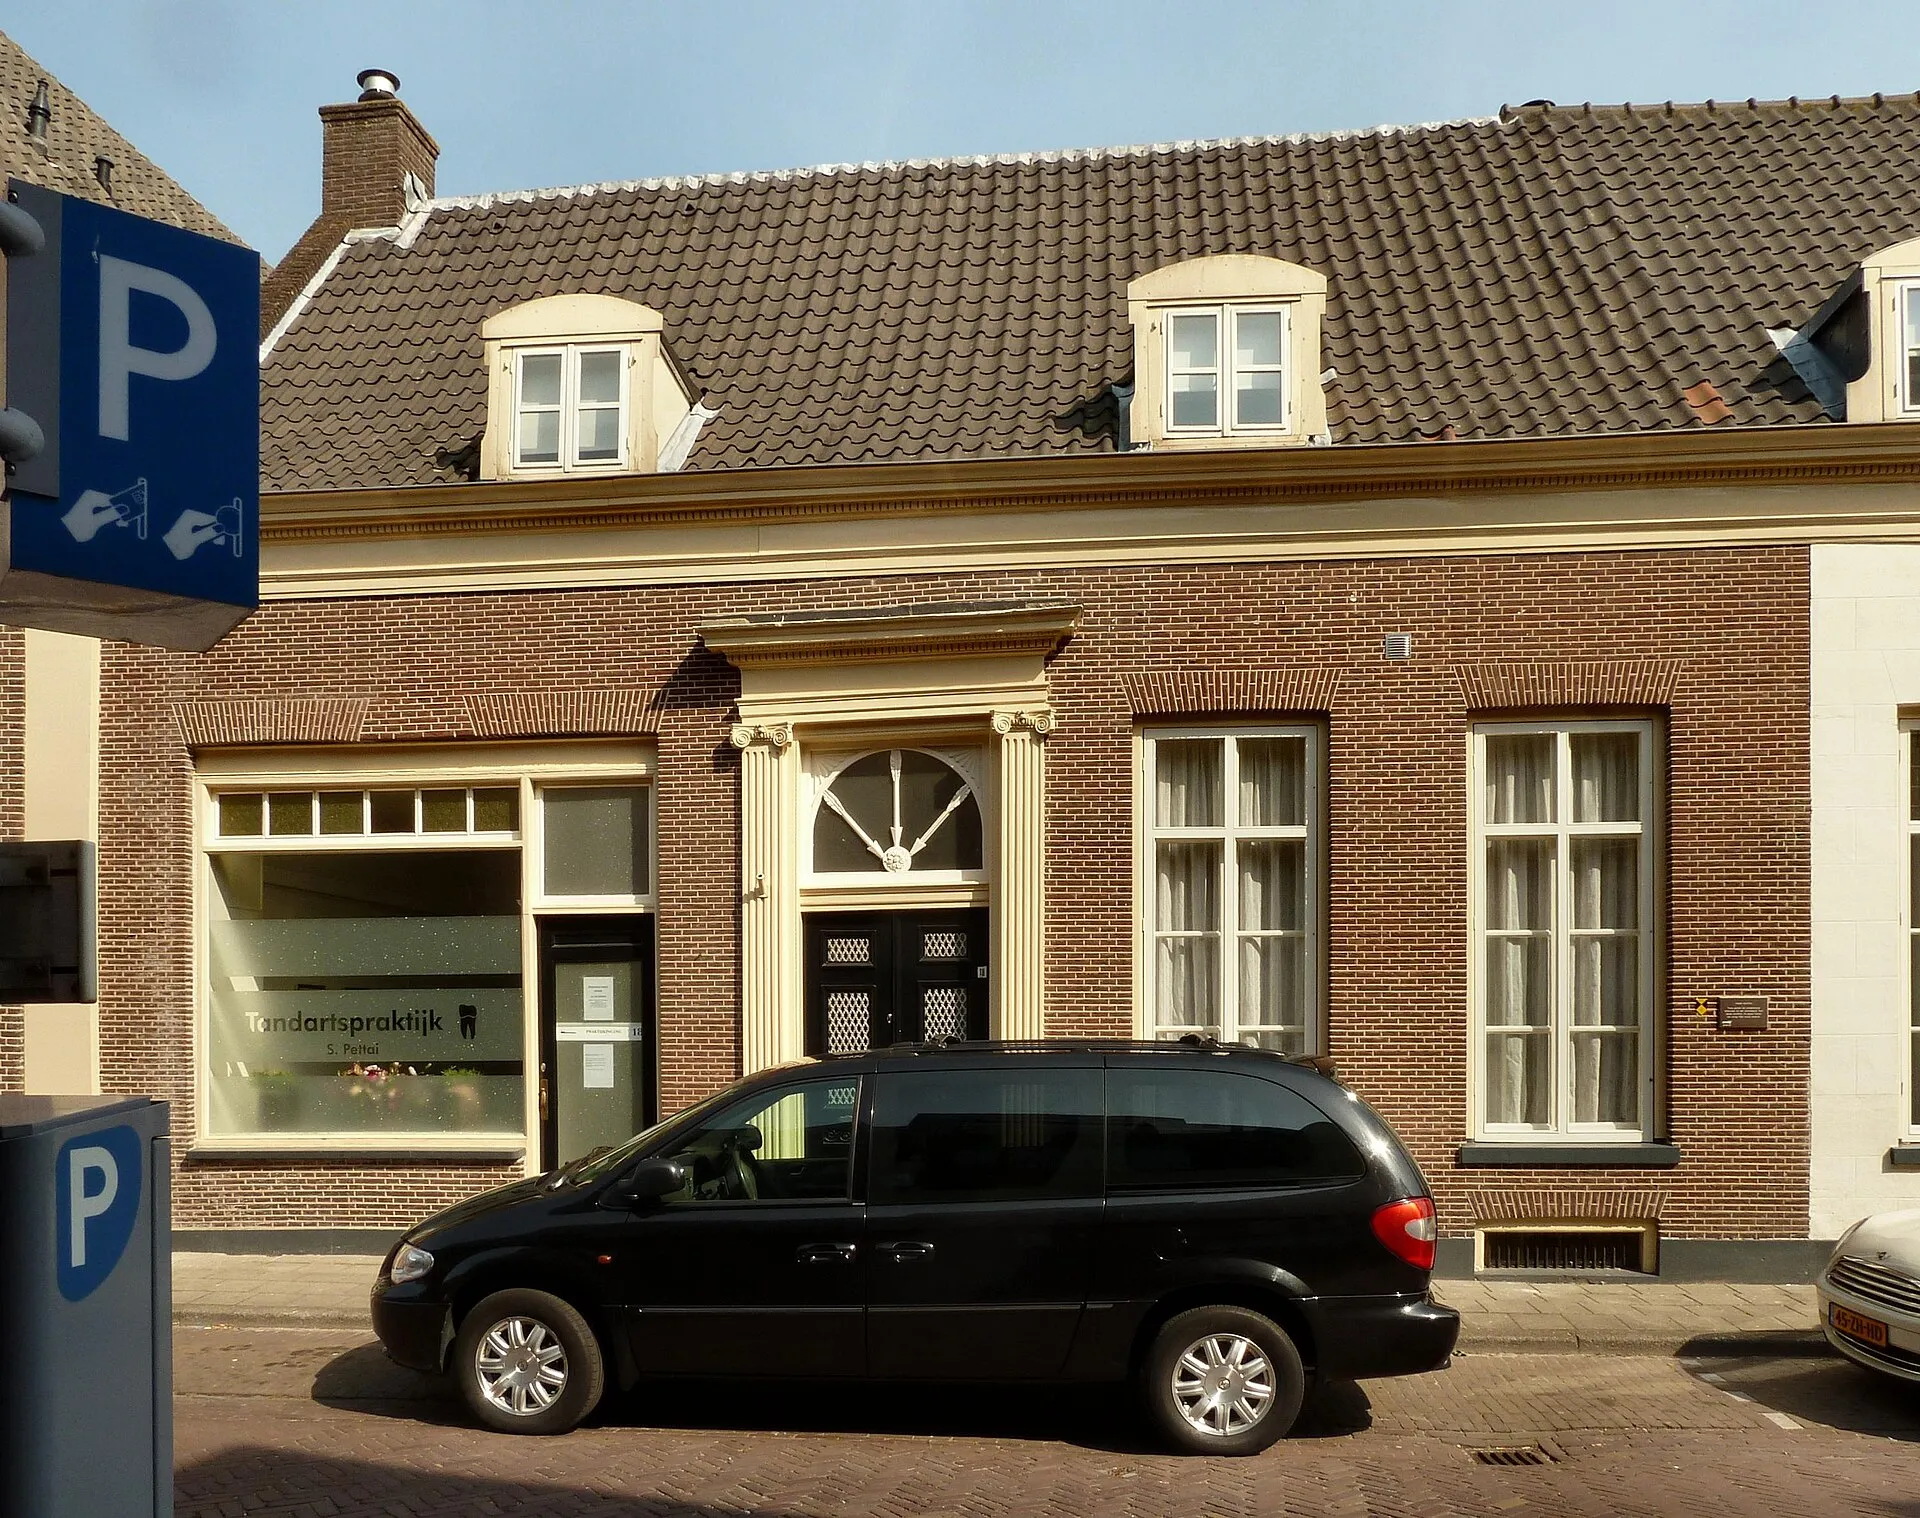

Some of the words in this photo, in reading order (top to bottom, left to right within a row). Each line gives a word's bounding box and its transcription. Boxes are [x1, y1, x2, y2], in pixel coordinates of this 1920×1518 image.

[98, 253, 218, 442] P
[245, 1009, 443, 1037] Tandartspraktijk
[326, 1043, 338, 1056] S.
[343, 1043, 380, 1056] Pettai
[69, 1146, 119, 1268] P
